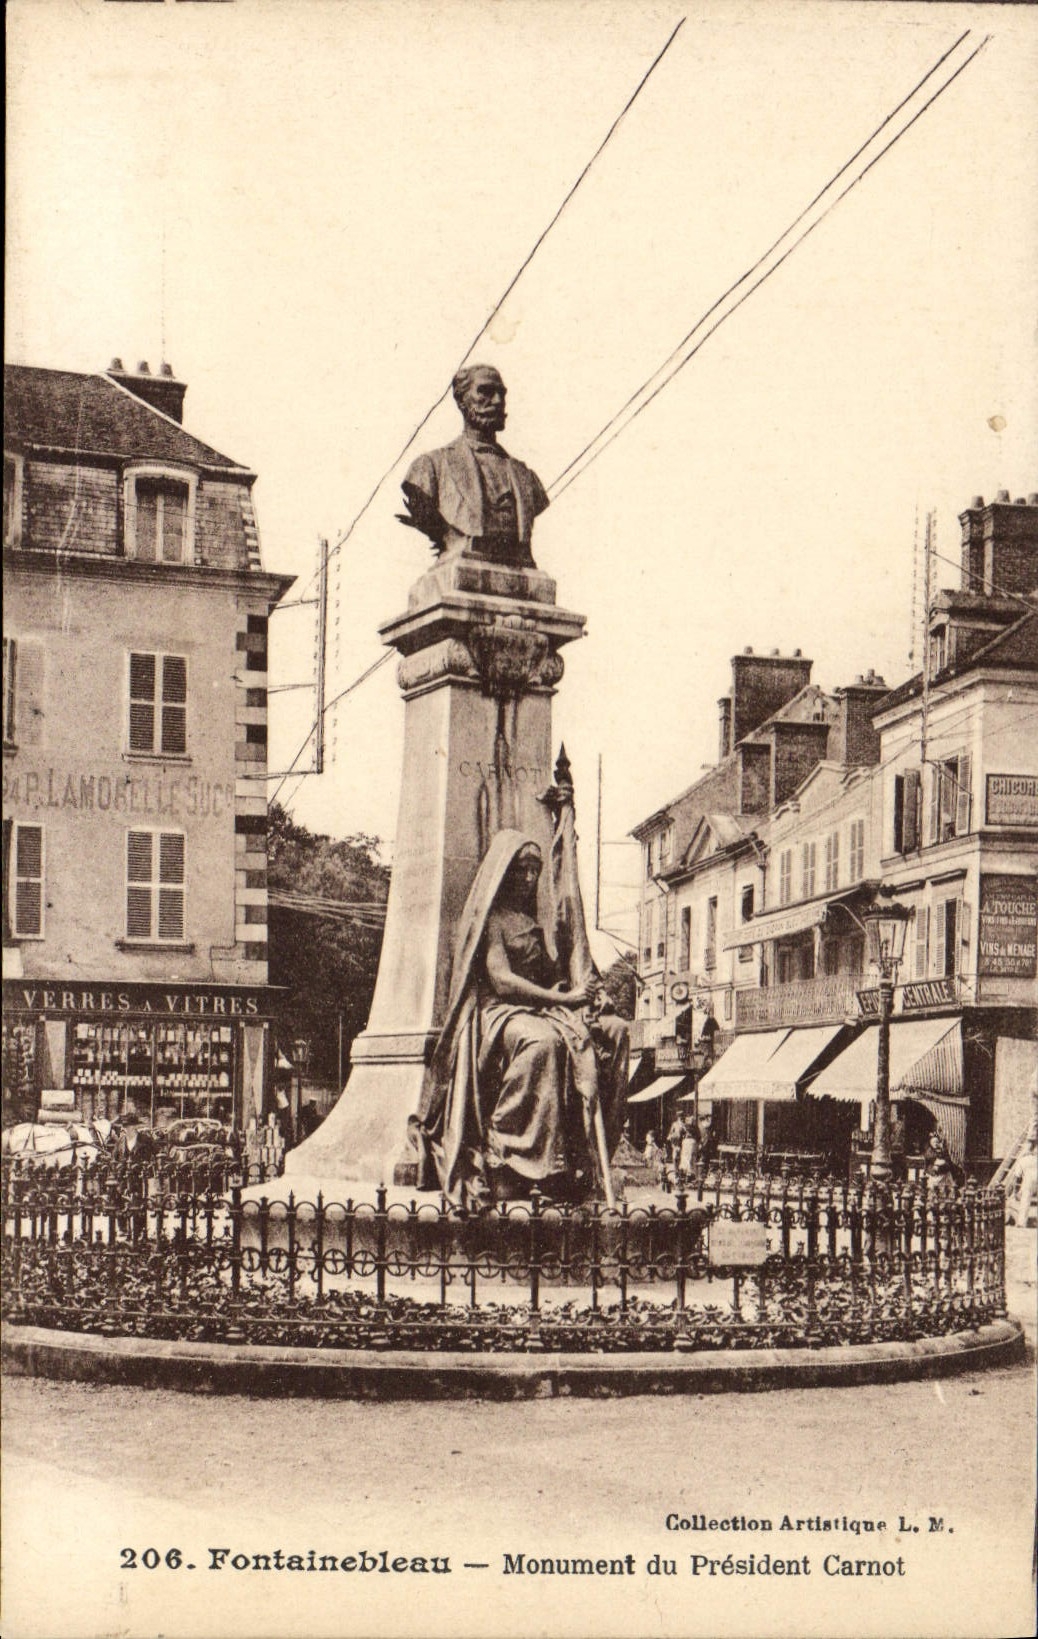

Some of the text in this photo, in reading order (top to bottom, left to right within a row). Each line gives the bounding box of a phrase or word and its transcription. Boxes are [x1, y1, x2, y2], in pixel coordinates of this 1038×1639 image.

[992, 777, 1038, 797] CHICOR
[980, 941, 1000, 957] VINS
[23, 990, 130, 1012] VERRES
[165, 995, 259, 1015] VITRES
[902, 981, 953, 1008] CENTRALE
